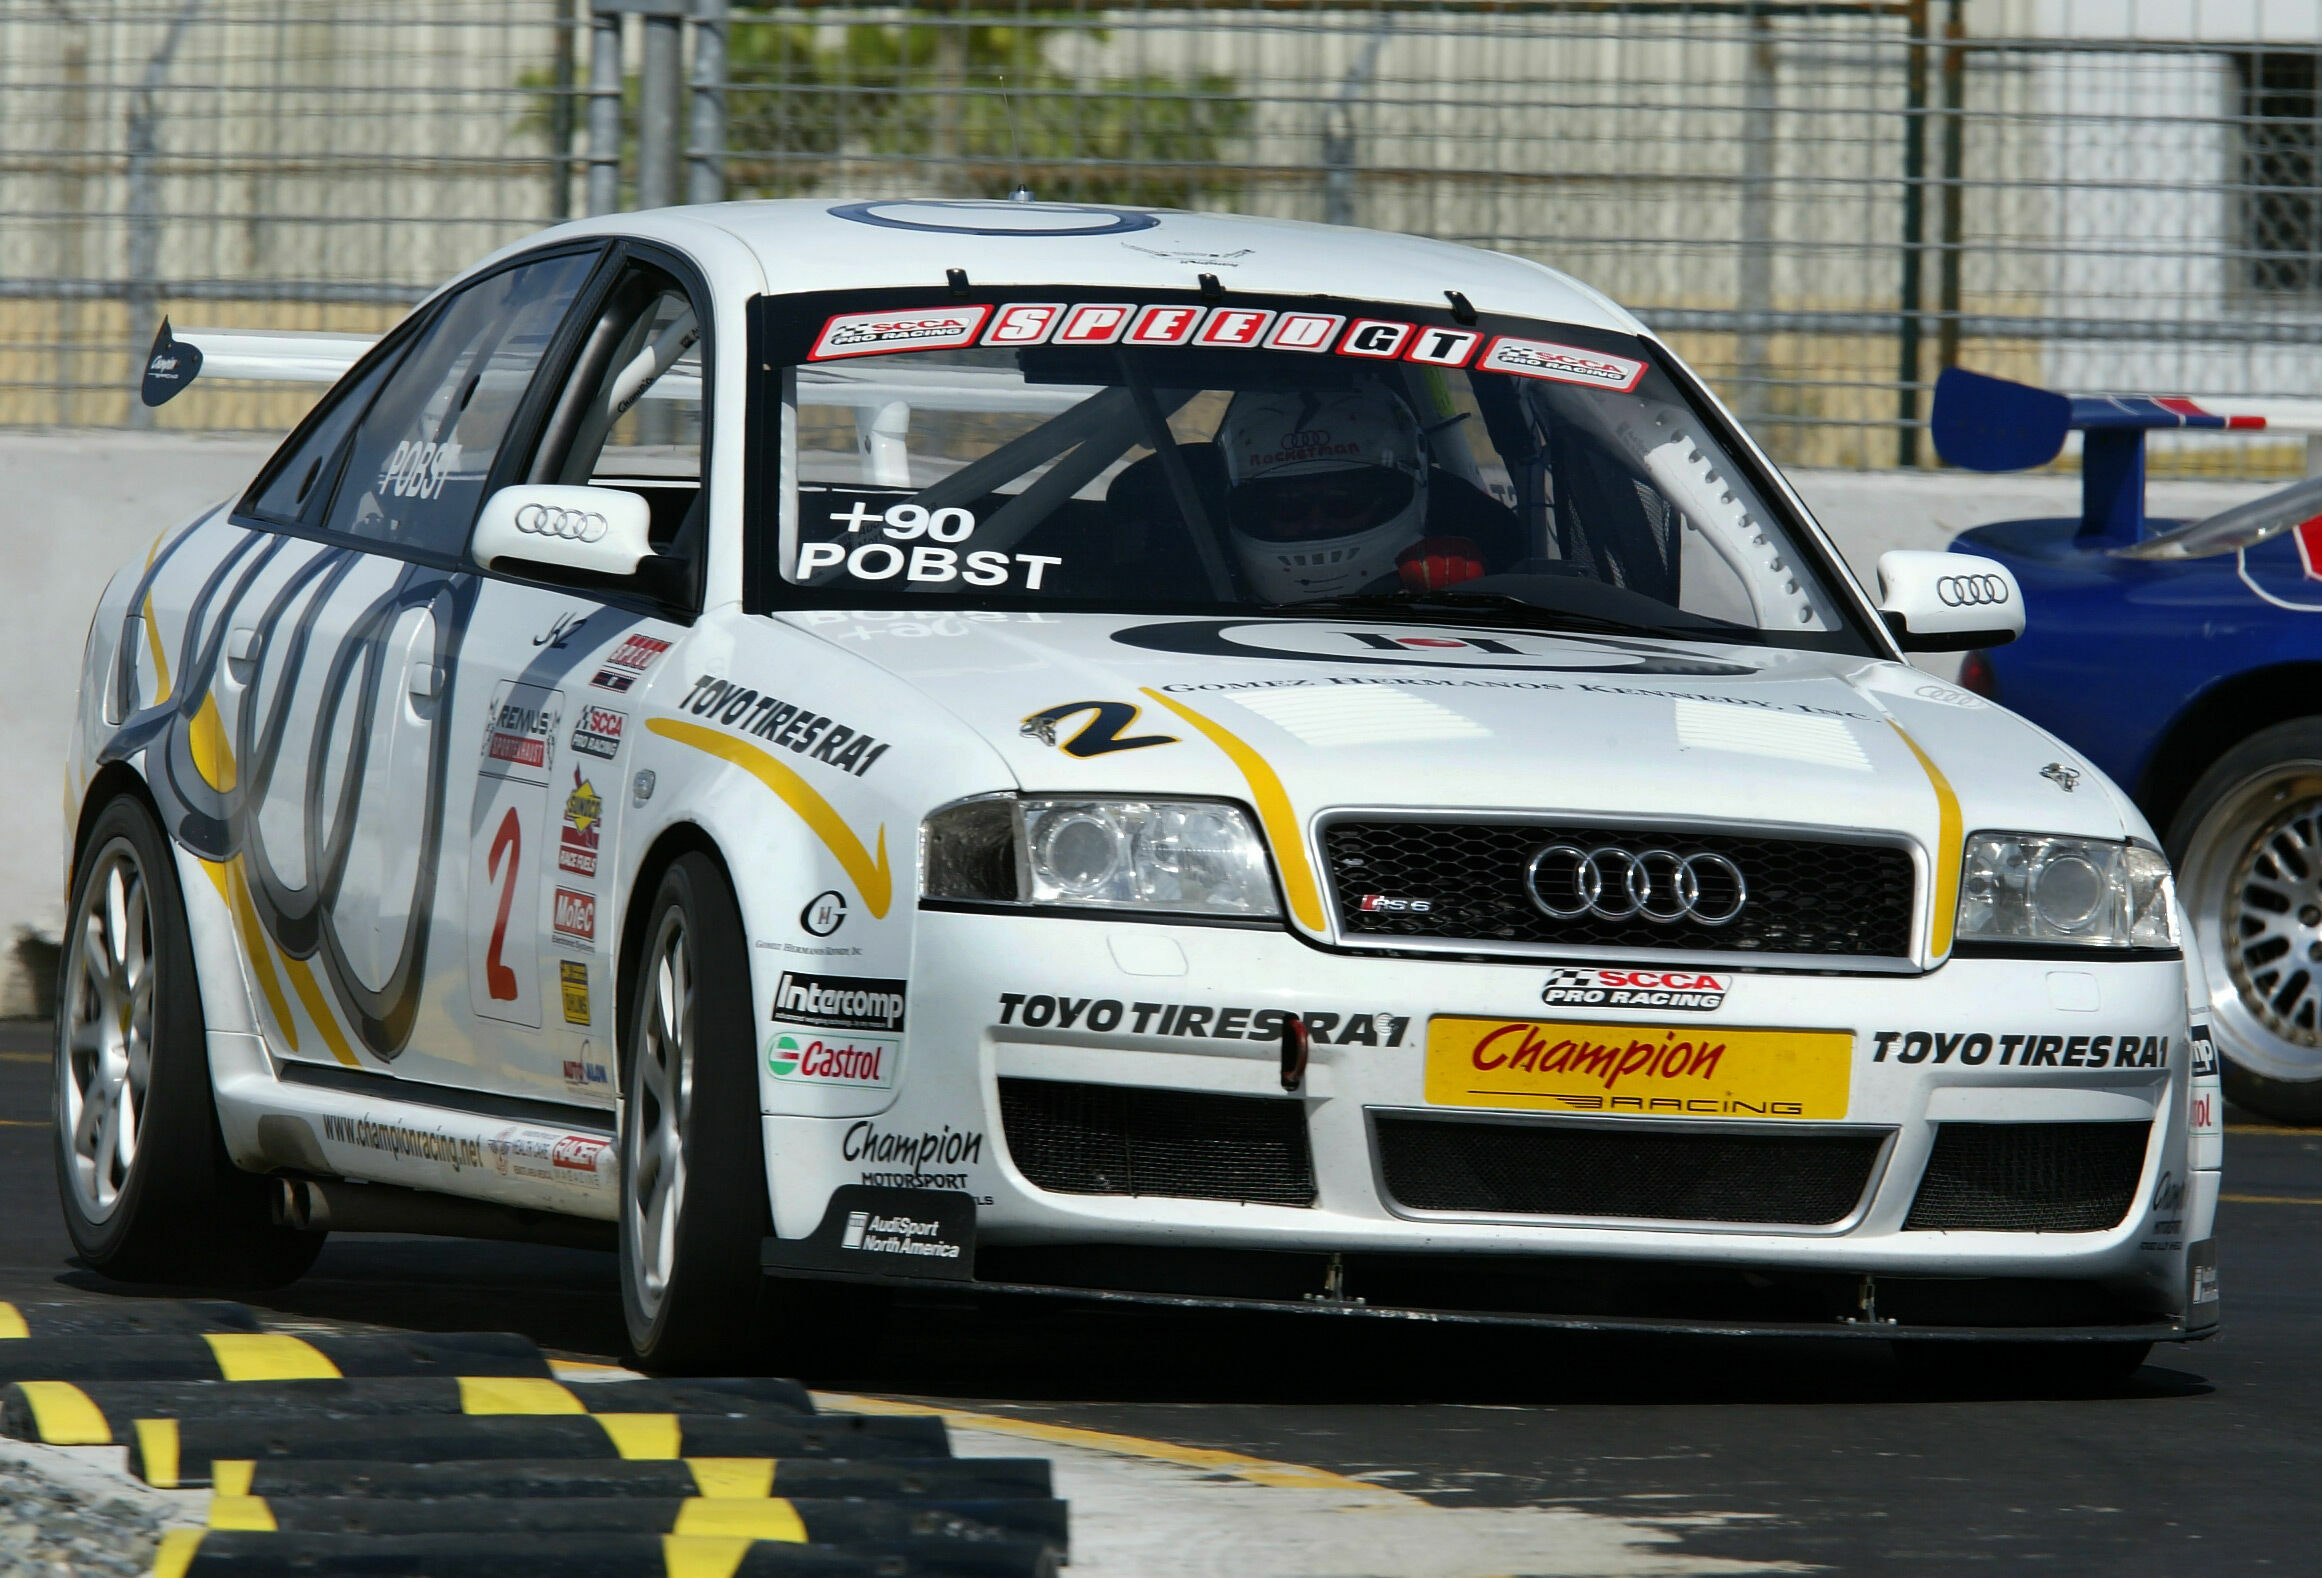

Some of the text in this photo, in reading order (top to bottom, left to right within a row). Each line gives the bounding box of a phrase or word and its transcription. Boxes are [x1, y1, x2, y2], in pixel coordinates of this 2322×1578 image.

[834, 328, 961, 345] PRO RACING
[871, 318, 962, 331] SCCA
[996, 308, 1469, 359] SPEED GT
[1499, 356, 1623, 380] PRO RACING
[1536, 352, 1624, 374] SCCA
[379, 440, 463, 499] POBST
[829, 501, 976, 543] +90
[796, 542, 1063, 590] POBST
[1162, 678, 1316, 693] GOMEZ
[1326, 677, 1565, 691] HERMANOS
[497, 704, 550, 735] REMUS
[679, 674, 892, 777] TOYO TIRES RA1
[1019, 700, 1183, 760] 2
[486, 806, 522, 1001] 2
[555, 894, 593, 932] MoTeC
[1546, 990, 1722, 1008] PRO RACING
[1599, 971, 1724, 990] SCCA
[777, 974, 905, 1028] Intercomp
[999, 993, 1411, 1047] TOYO TIRES RA1
[801, 1041, 882, 1080] Castrol
[1472, 1023, 1727, 1090] Champion
[1872, 1031, 1994, 1065] TOYO
[1998, 1035, 2111, 1068] TIRES
[2114, 1036, 2169, 1068] RA1
[1608, 1095, 1803, 1115] RACING
[323, 1112, 484, 1173] www.championracing.net
[843, 1120, 982, 1172] Champion
[861, 1172, 968, 1189] MOTORSPORT
